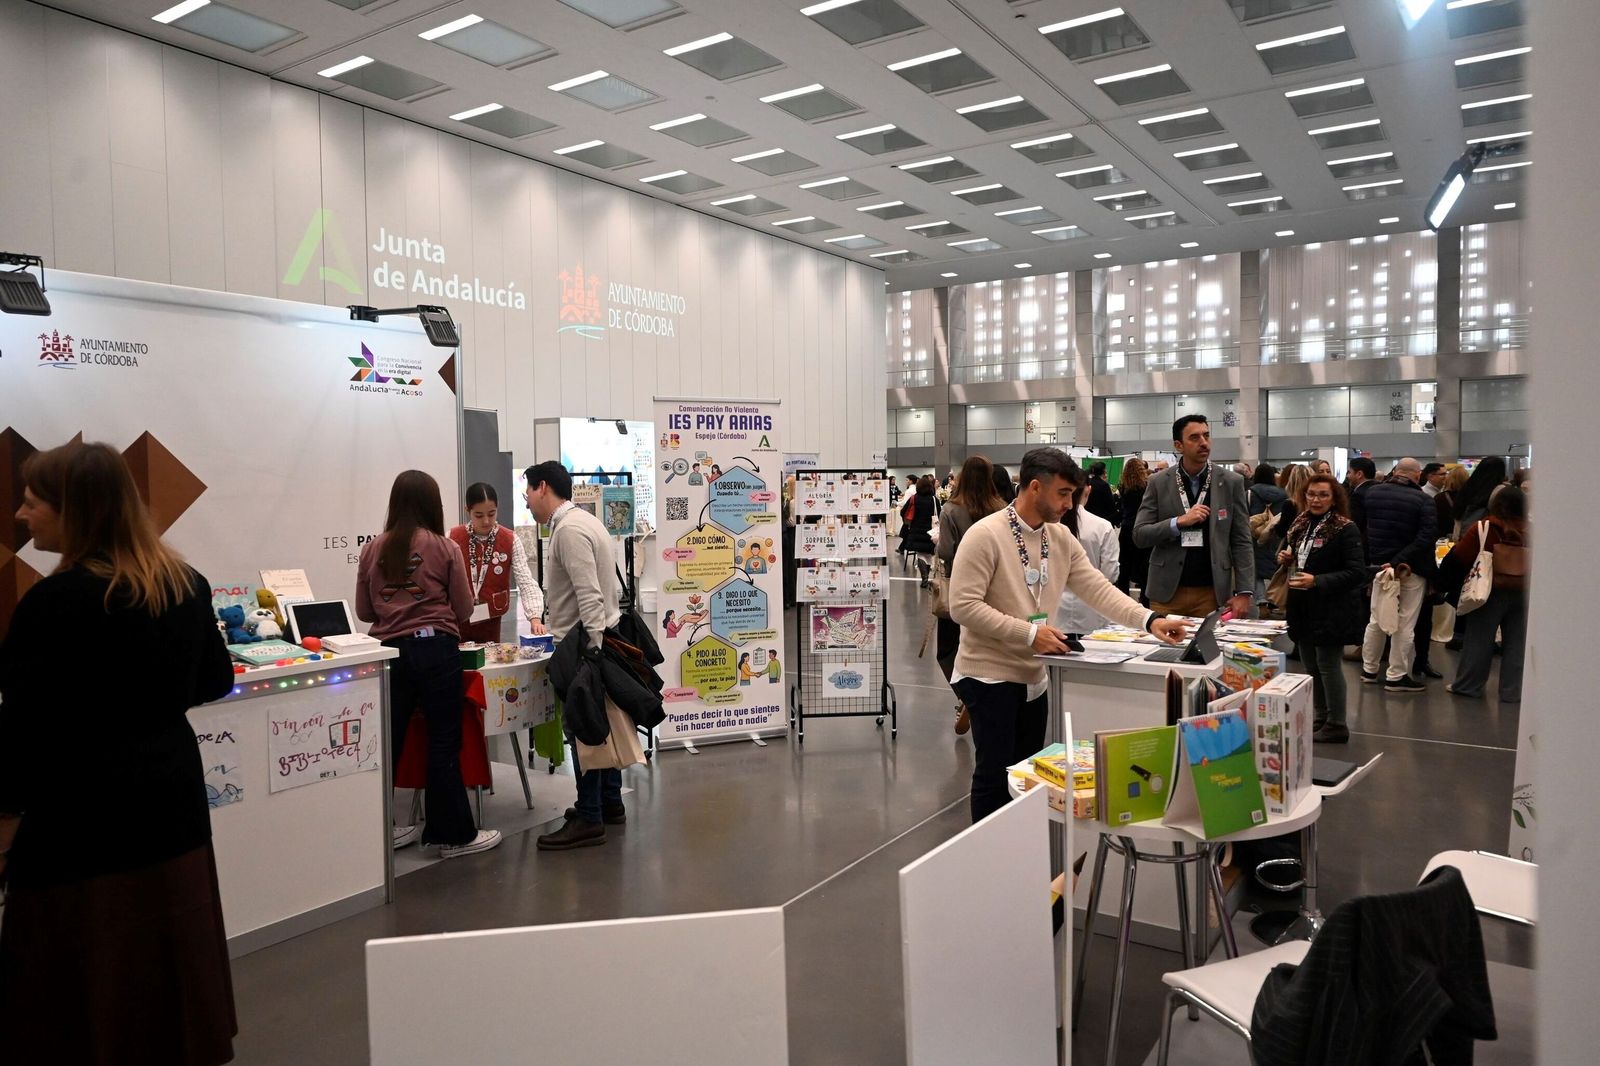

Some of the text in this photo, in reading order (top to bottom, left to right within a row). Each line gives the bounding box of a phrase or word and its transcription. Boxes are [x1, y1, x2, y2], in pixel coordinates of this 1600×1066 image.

[372, 227, 446, 264] Junta
[373, 261, 526, 310] de Andalucía
[608, 282, 686, 315] AYUNTAMIENTO
[608, 308, 675, 337] DE CÓRDOBA
[80, 338, 149, 355] AYUNTAMIENTO
[80, 352, 138, 367] DE CÓRDOBA
[401, 388, 423, 396] Acoso
[679, 405, 723, 413] Comunicación
[734, 406, 759, 414] Violenta
[669, 414, 772, 430] IES PAY ARIAS
[695, 432, 747, 440] Espejo (Córdoba)
[323, 534, 376, 550] IES PA
[708, 534, 726, 544] CÓMO
[806, 536, 834, 544] SORPRESA
[740, 590, 746, 598] LO
[748, 590, 758, 598] QUE
[726, 599, 751, 607] NECESITO
[696, 649, 709, 658] PIDO
[712, 648, 726, 656] ALGO
[695, 658, 726, 667] CONCRETO
[702, 710, 722, 719] decir
[724, 708, 731, 716] lo
[734, 708, 748, 718] que
[750, 705, 780, 714] sientes
[676, 723, 688, 732] sin
[691, 721, 714, 730] hacer
[716, 718, 736, 727] daño
